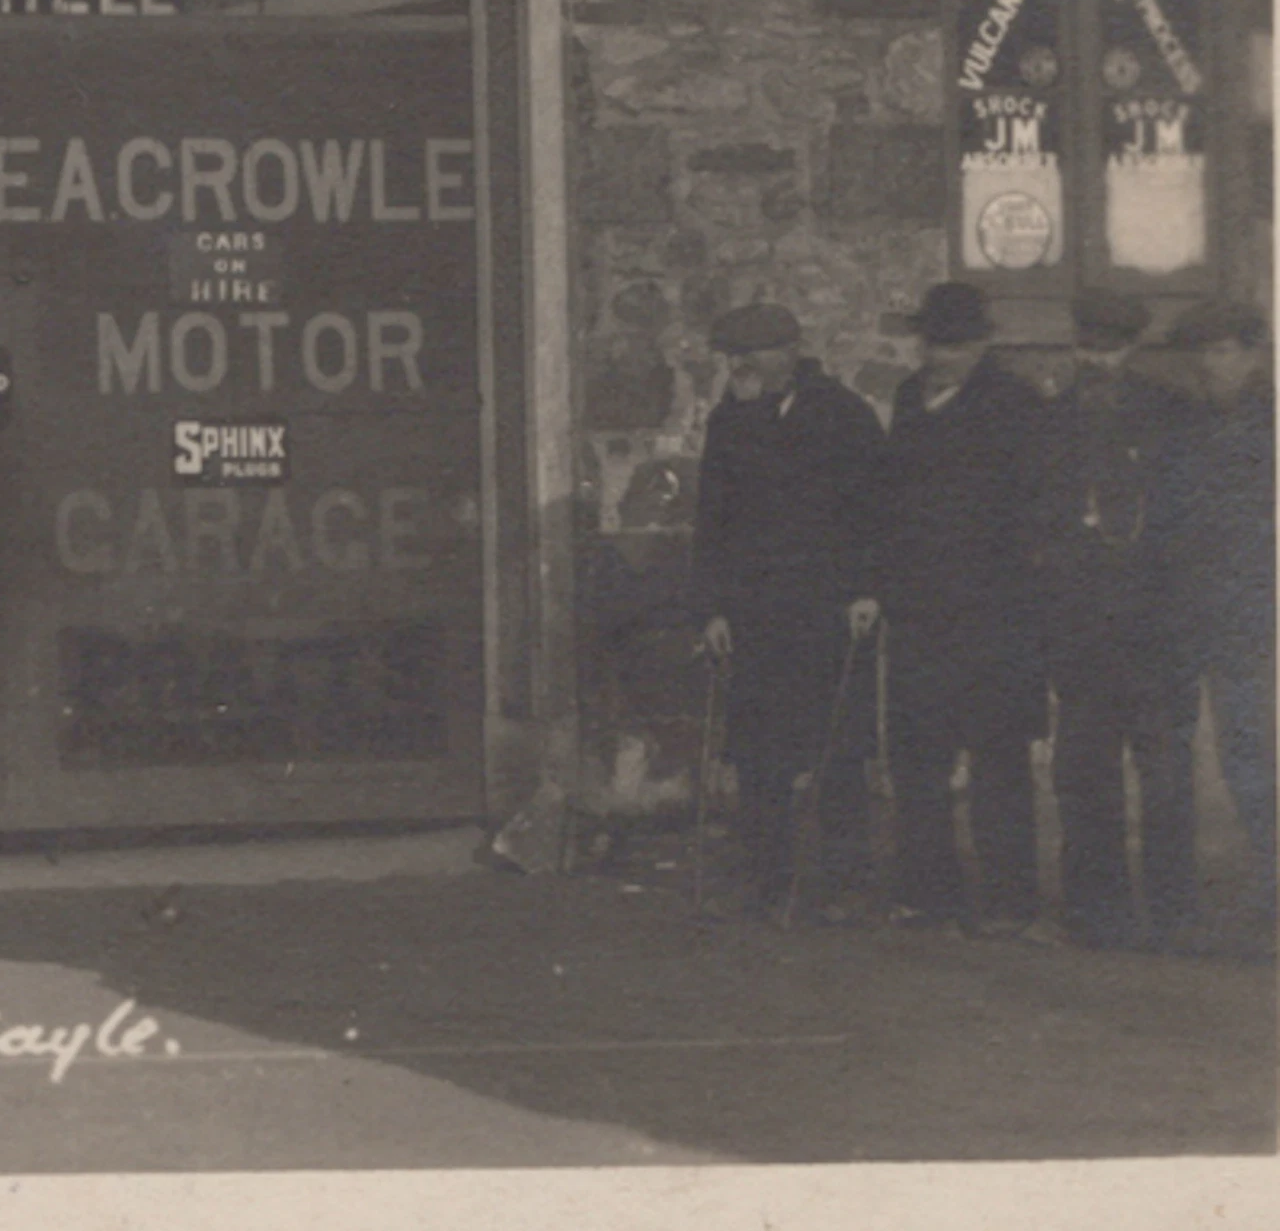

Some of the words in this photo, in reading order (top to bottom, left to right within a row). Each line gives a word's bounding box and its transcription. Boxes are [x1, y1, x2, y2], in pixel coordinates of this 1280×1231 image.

[973, 95, 1048, 120] SHOCK
[196, 232, 266, 251] CARS
[213, 259, 247, 273] ON
[190, 279, 275, 303] HIRE
[96, 310, 426, 396] MOTOR
[174, 420, 286, 475] SPHINX
[222, 462, 282, 478] PLUGS
[55, 486, 431, 574] GARAGE
